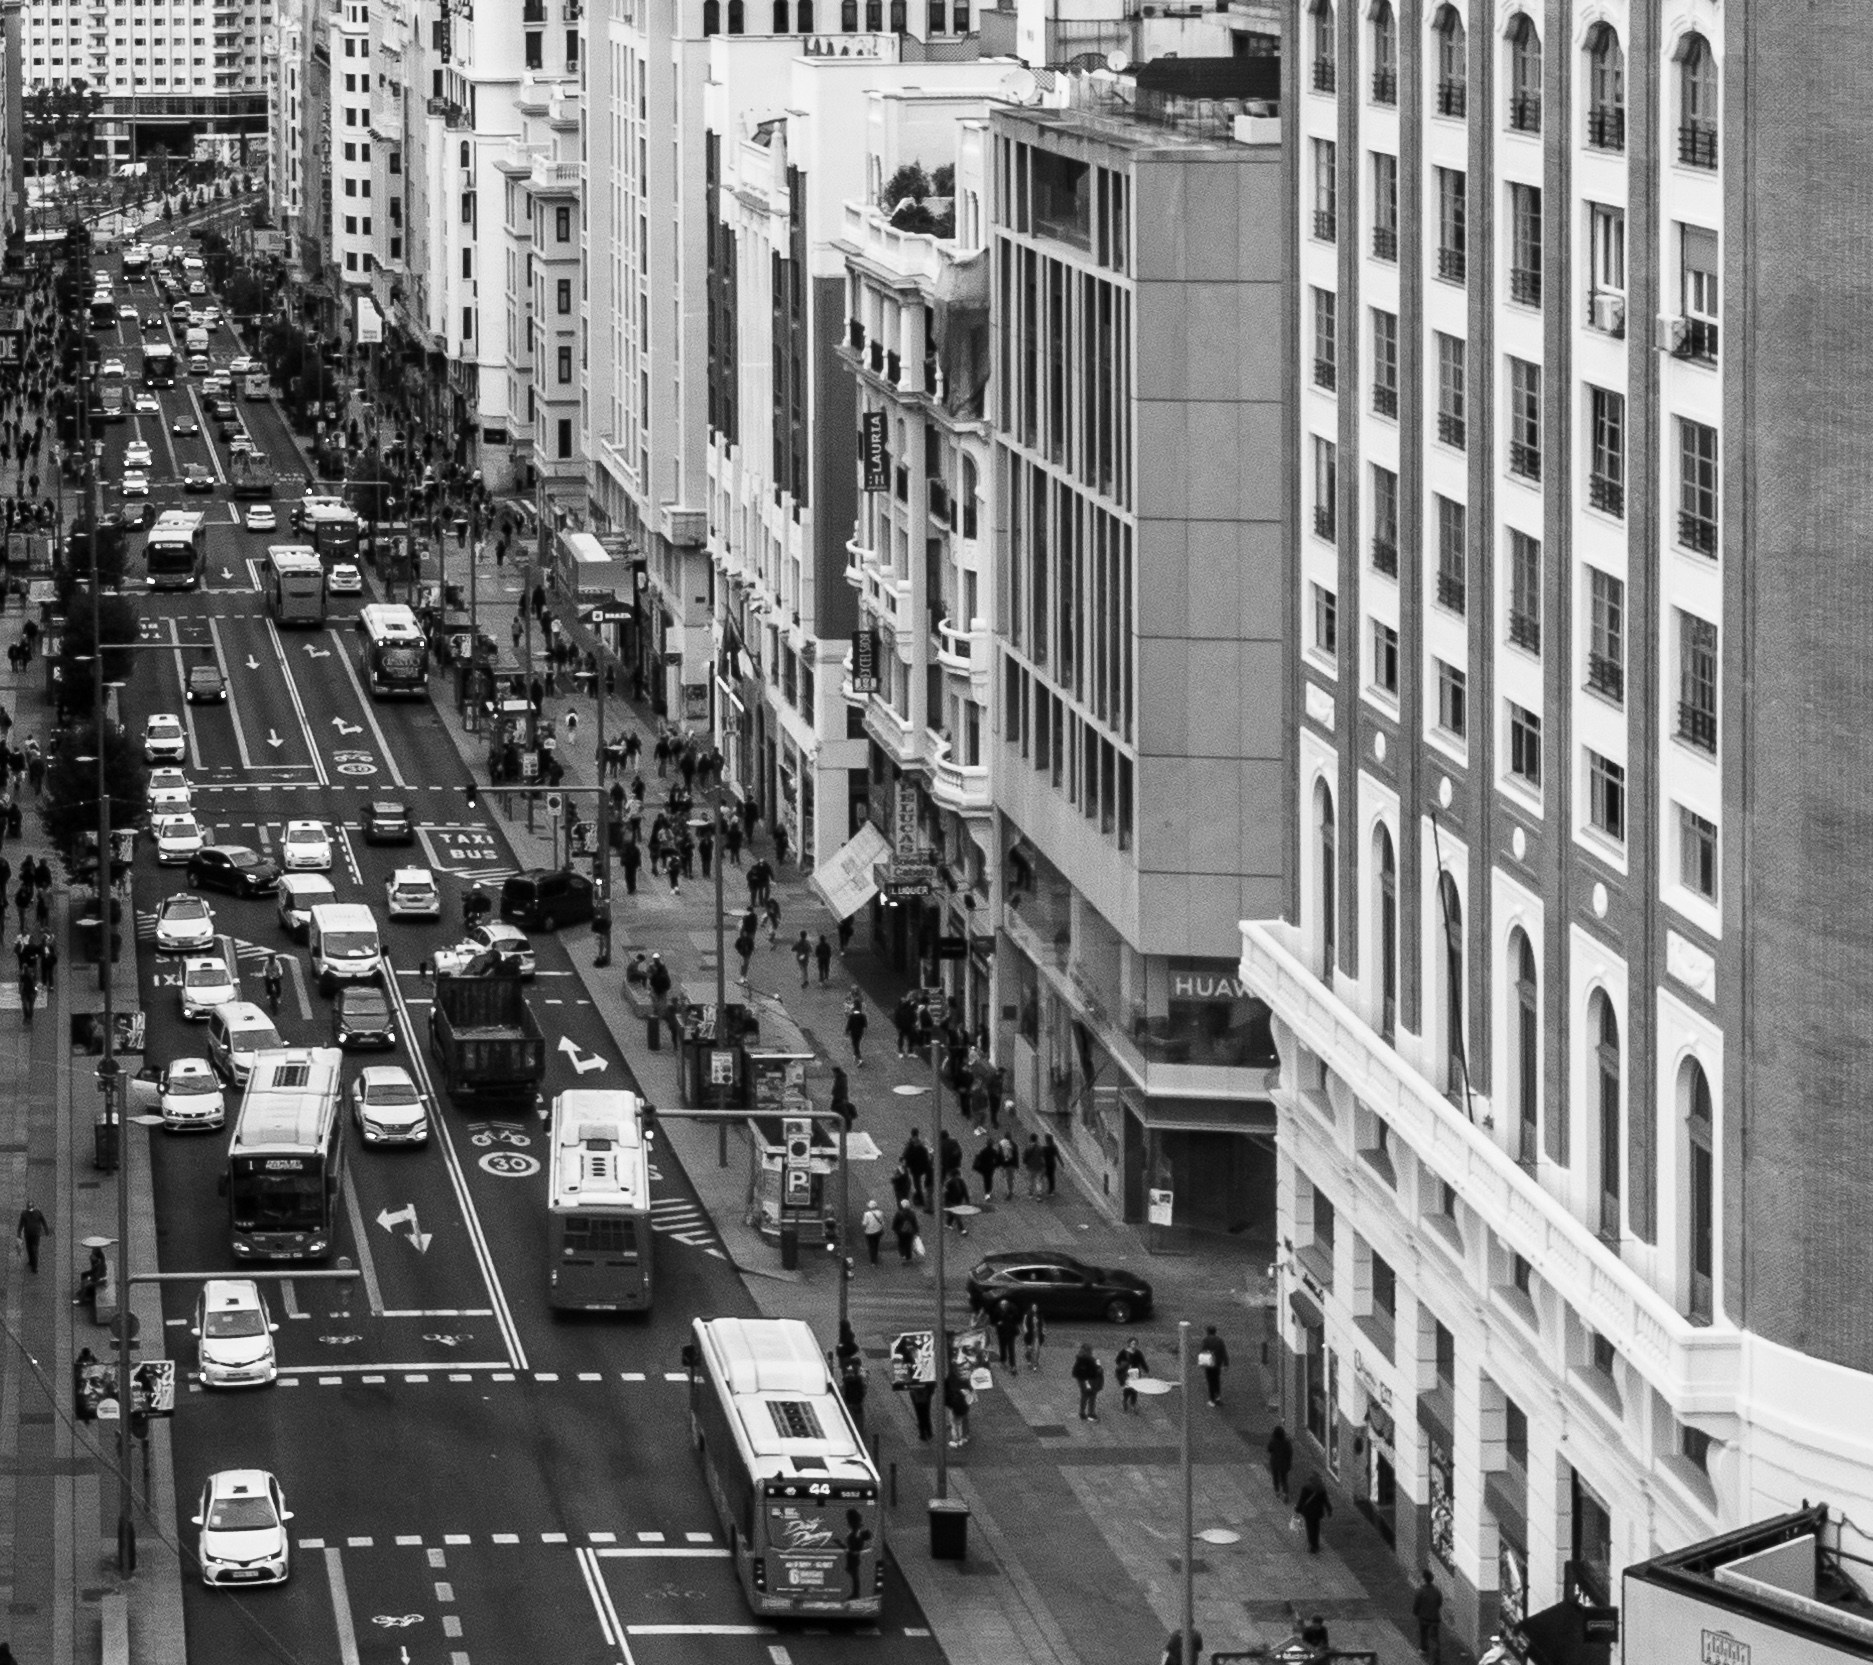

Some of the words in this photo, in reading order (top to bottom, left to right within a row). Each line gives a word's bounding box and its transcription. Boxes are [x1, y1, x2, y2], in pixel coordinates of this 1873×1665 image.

[870, 414, 882, 473] LAURIA
[439, 833, 494, 844] TAXI
[450, 849, 498, 860] BUS
[493, 1154, 528, 1174] 30
[788, 1170, 809, 1193] P
[809, 1483, 831, 1495] 44
